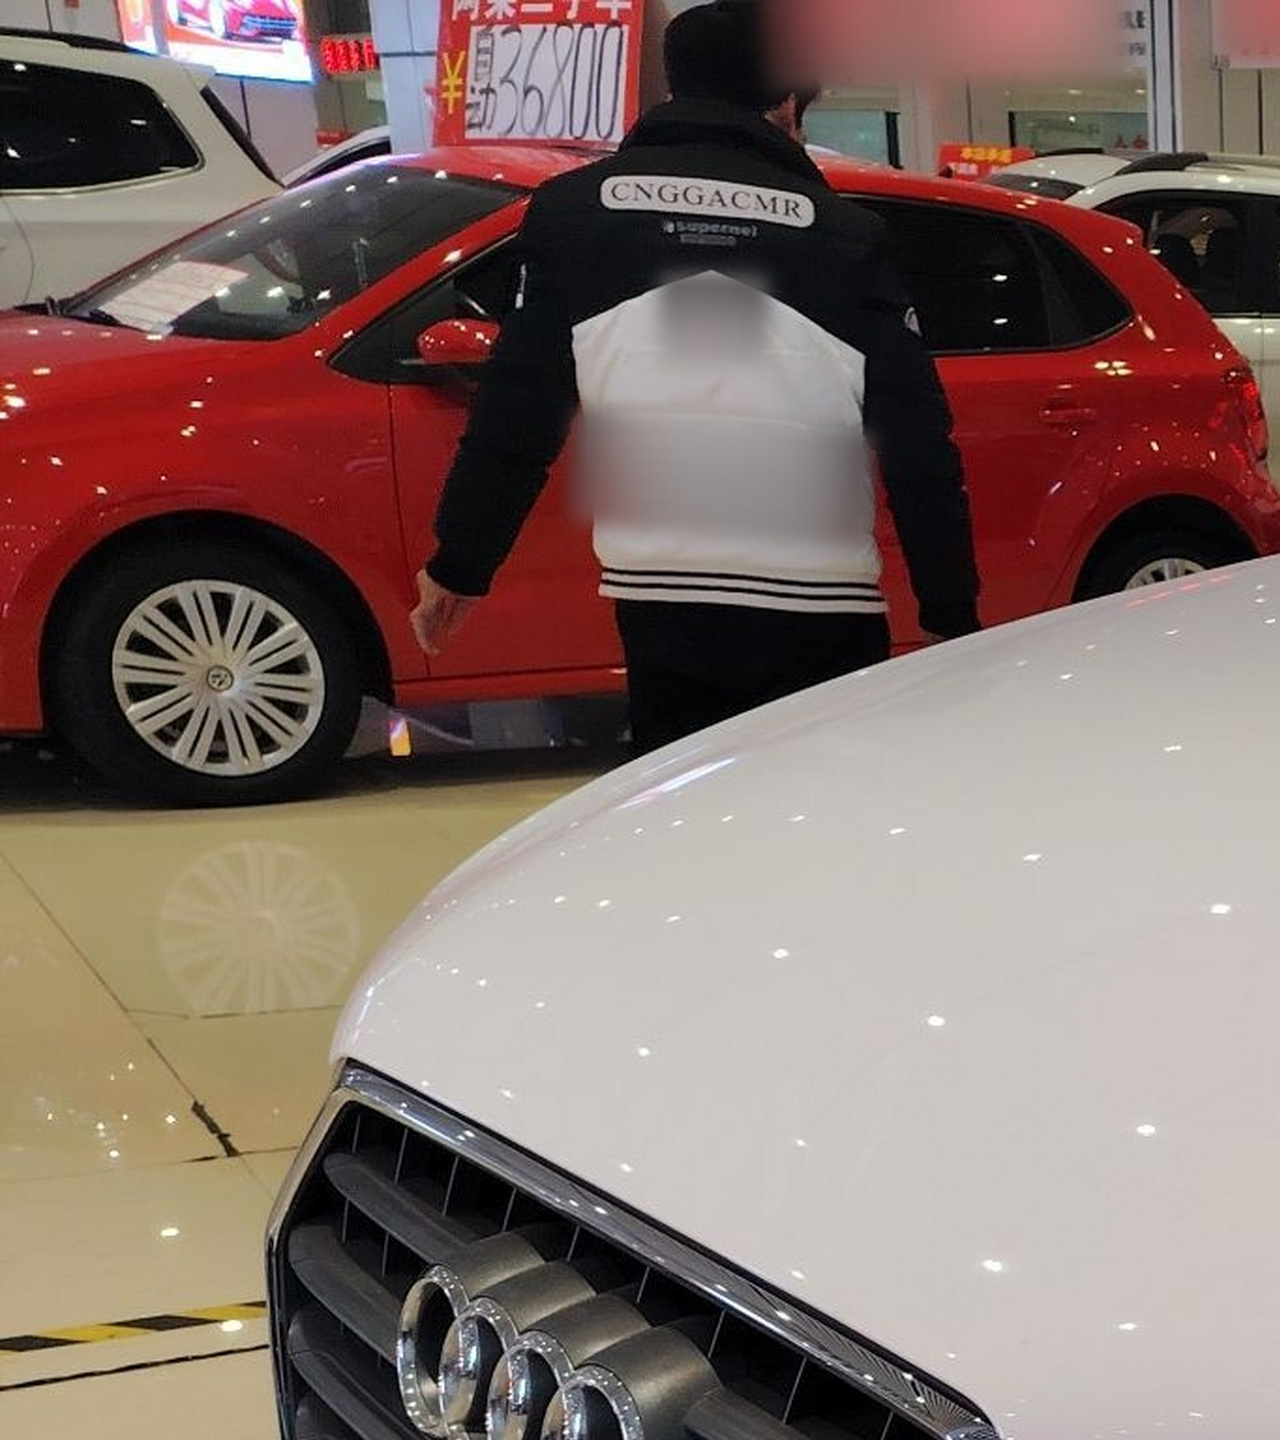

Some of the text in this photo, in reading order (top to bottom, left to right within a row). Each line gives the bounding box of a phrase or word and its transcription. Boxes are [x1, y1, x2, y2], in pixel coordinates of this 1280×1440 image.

[441, 50, 466, 114] ¥
[498, 20, 624, 140] 36800
[610, 181, 802, 220] CNGGACMR
